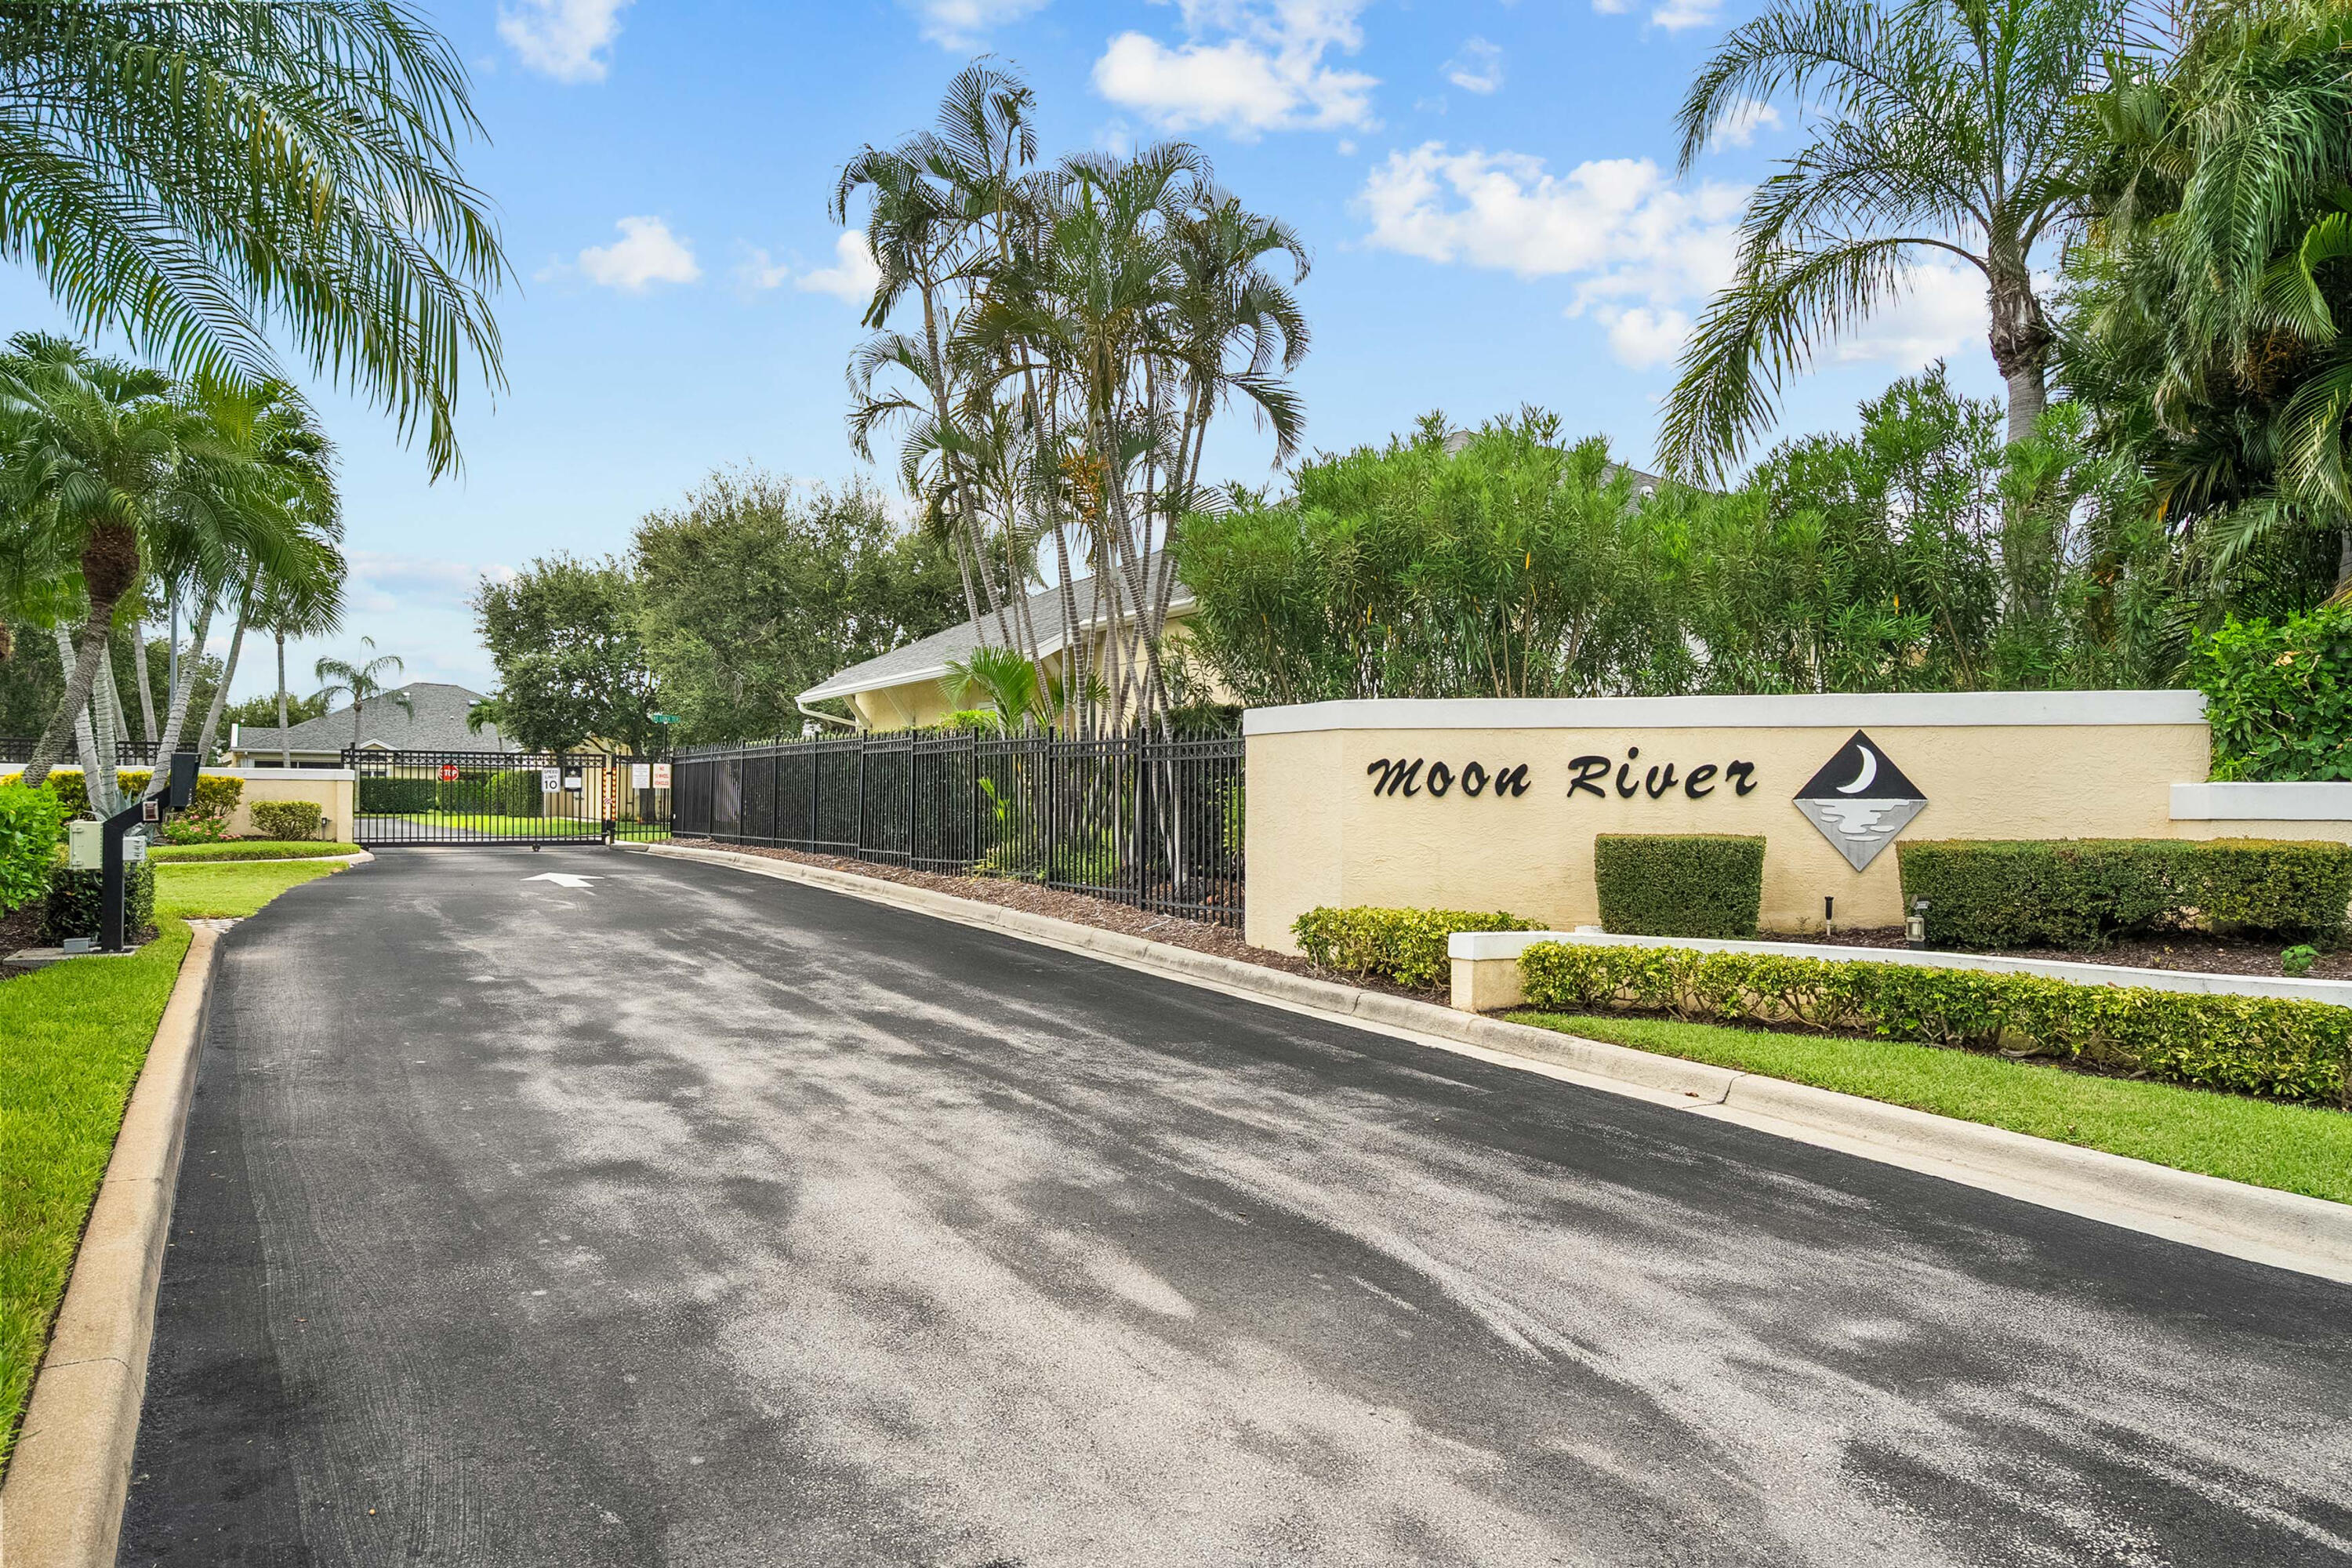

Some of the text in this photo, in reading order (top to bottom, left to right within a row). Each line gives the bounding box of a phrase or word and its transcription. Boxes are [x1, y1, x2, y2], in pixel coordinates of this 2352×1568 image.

[545, 780, 557, 789] 10
[1367, 746, 1758, 799] Moon River
